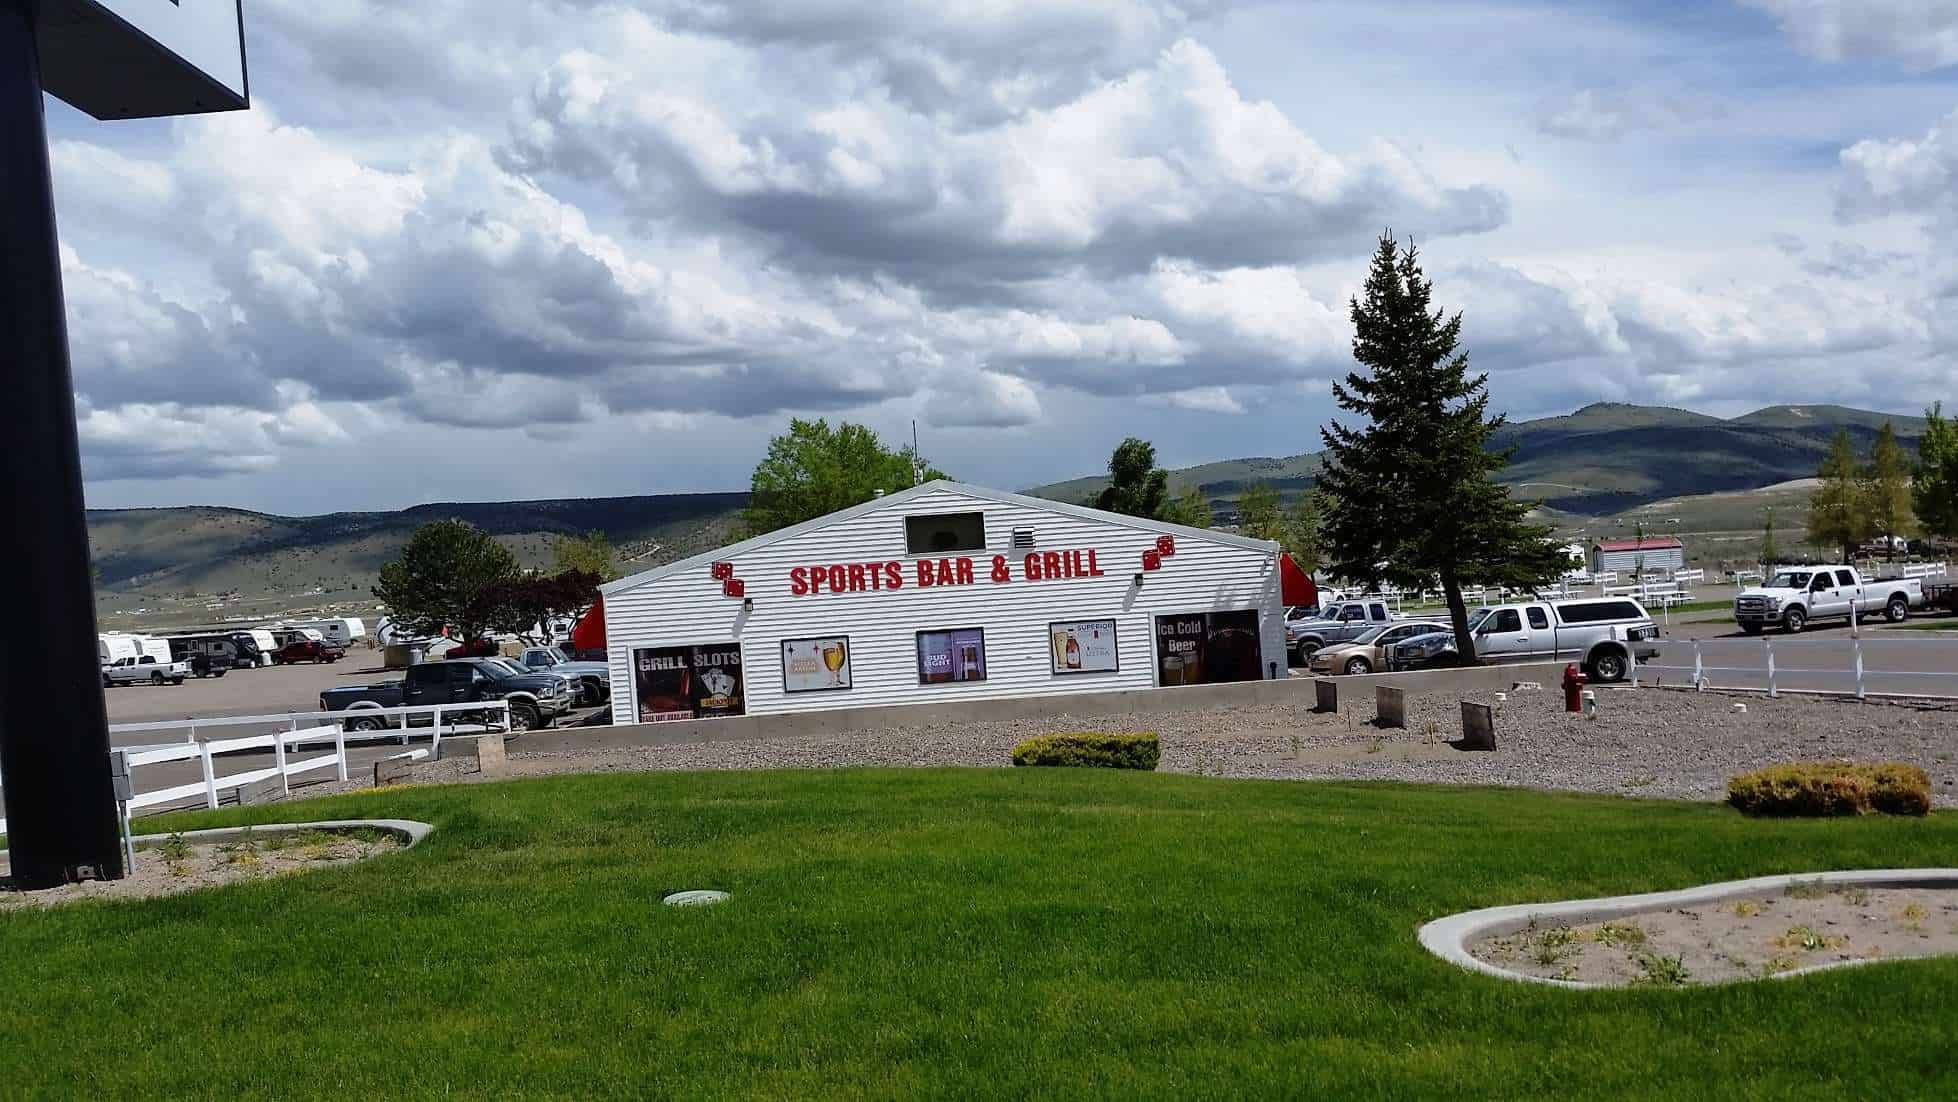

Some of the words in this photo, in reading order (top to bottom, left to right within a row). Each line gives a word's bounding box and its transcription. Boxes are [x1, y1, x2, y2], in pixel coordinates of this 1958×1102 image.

[790, 560, 903, 596] SPORTS
[917, 556, 974, 588] BAR
[990, 554, 1011, 582] &
[1024, 548, 1104, 580] GRILL
[1177, 620, 1202, 634] Cold
[1168, 639, 1196, 653] Beer
[639, 655, 688, 672] GRILL
[693, 651, 740, 667] SLOTS
